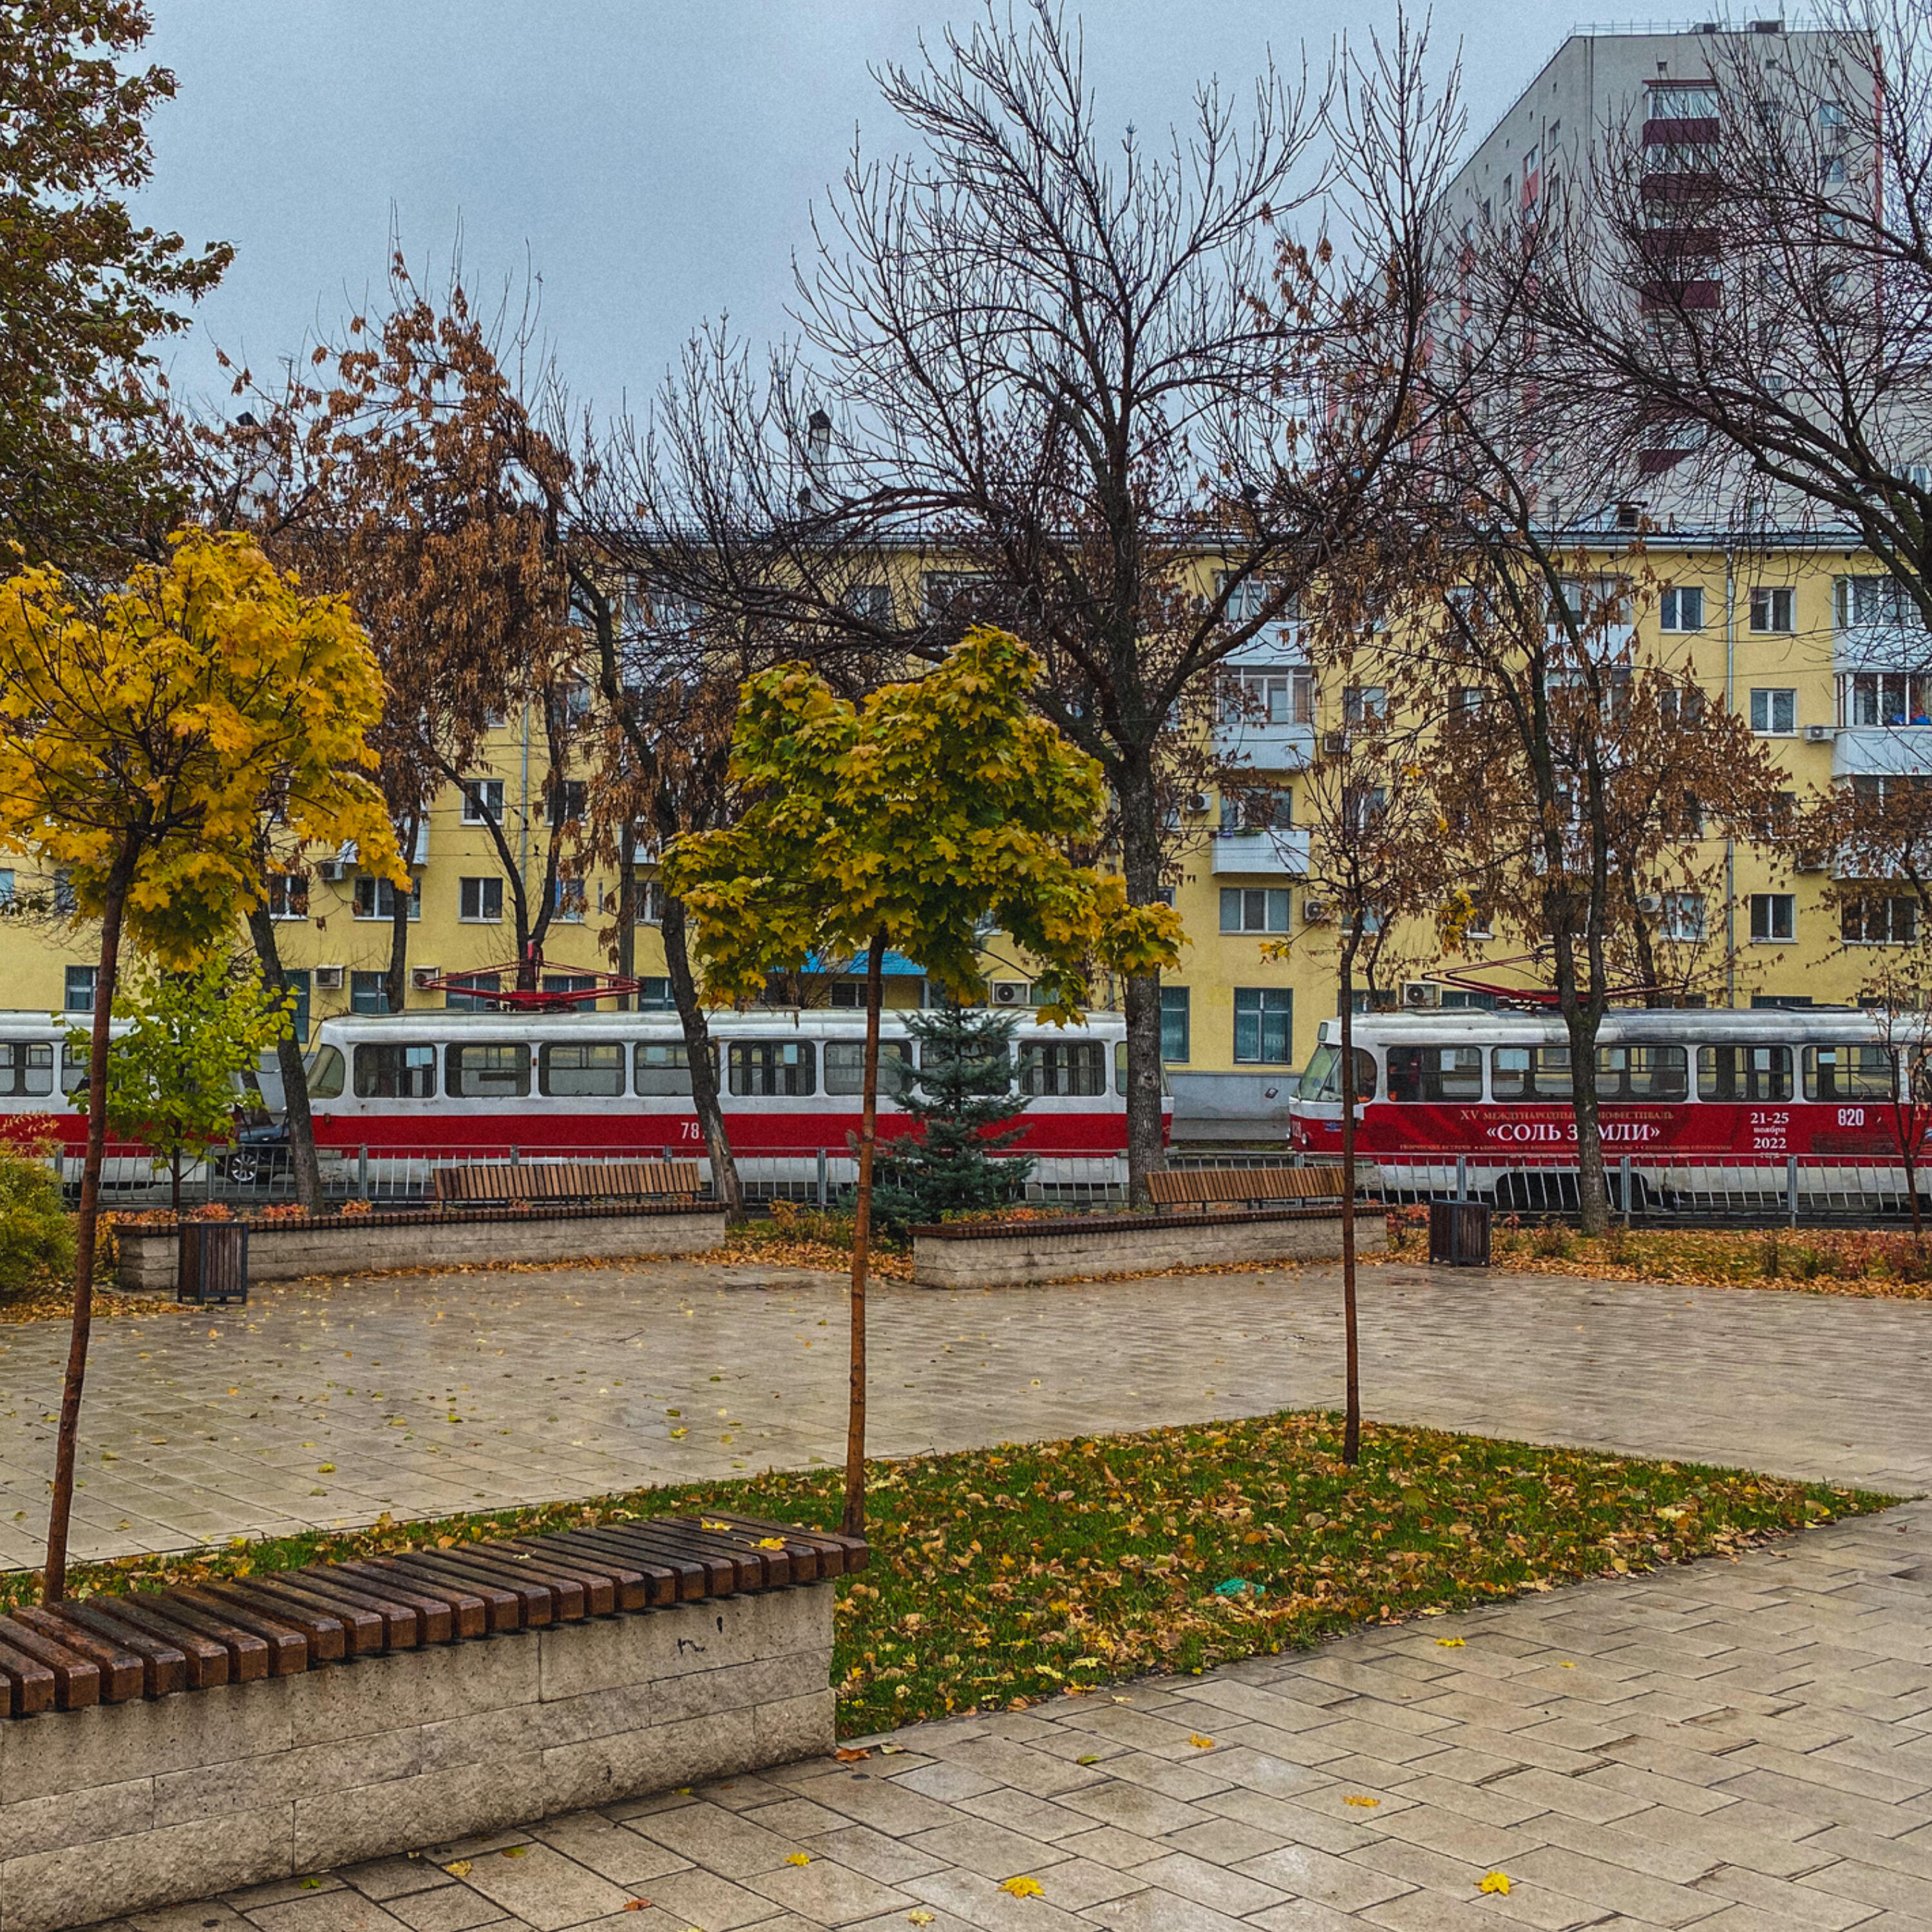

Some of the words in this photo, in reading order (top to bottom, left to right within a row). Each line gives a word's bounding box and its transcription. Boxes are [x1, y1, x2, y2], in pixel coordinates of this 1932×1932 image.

[1483, 1111, 1577, 1121] МЕЖДУНАРОДНЫ
[1750, 1112, 1789, 1124] 21-25
[1837, 1108, 1864, 1126] 820
[681, 1122, 705, 1139] 78
[1486, 1124, 1562, 1141] «СОЛЬ
[1567, 1124, 1661, 1141] ЗМЛИ»
[1753, 1137, 1787, 1149] 2022
